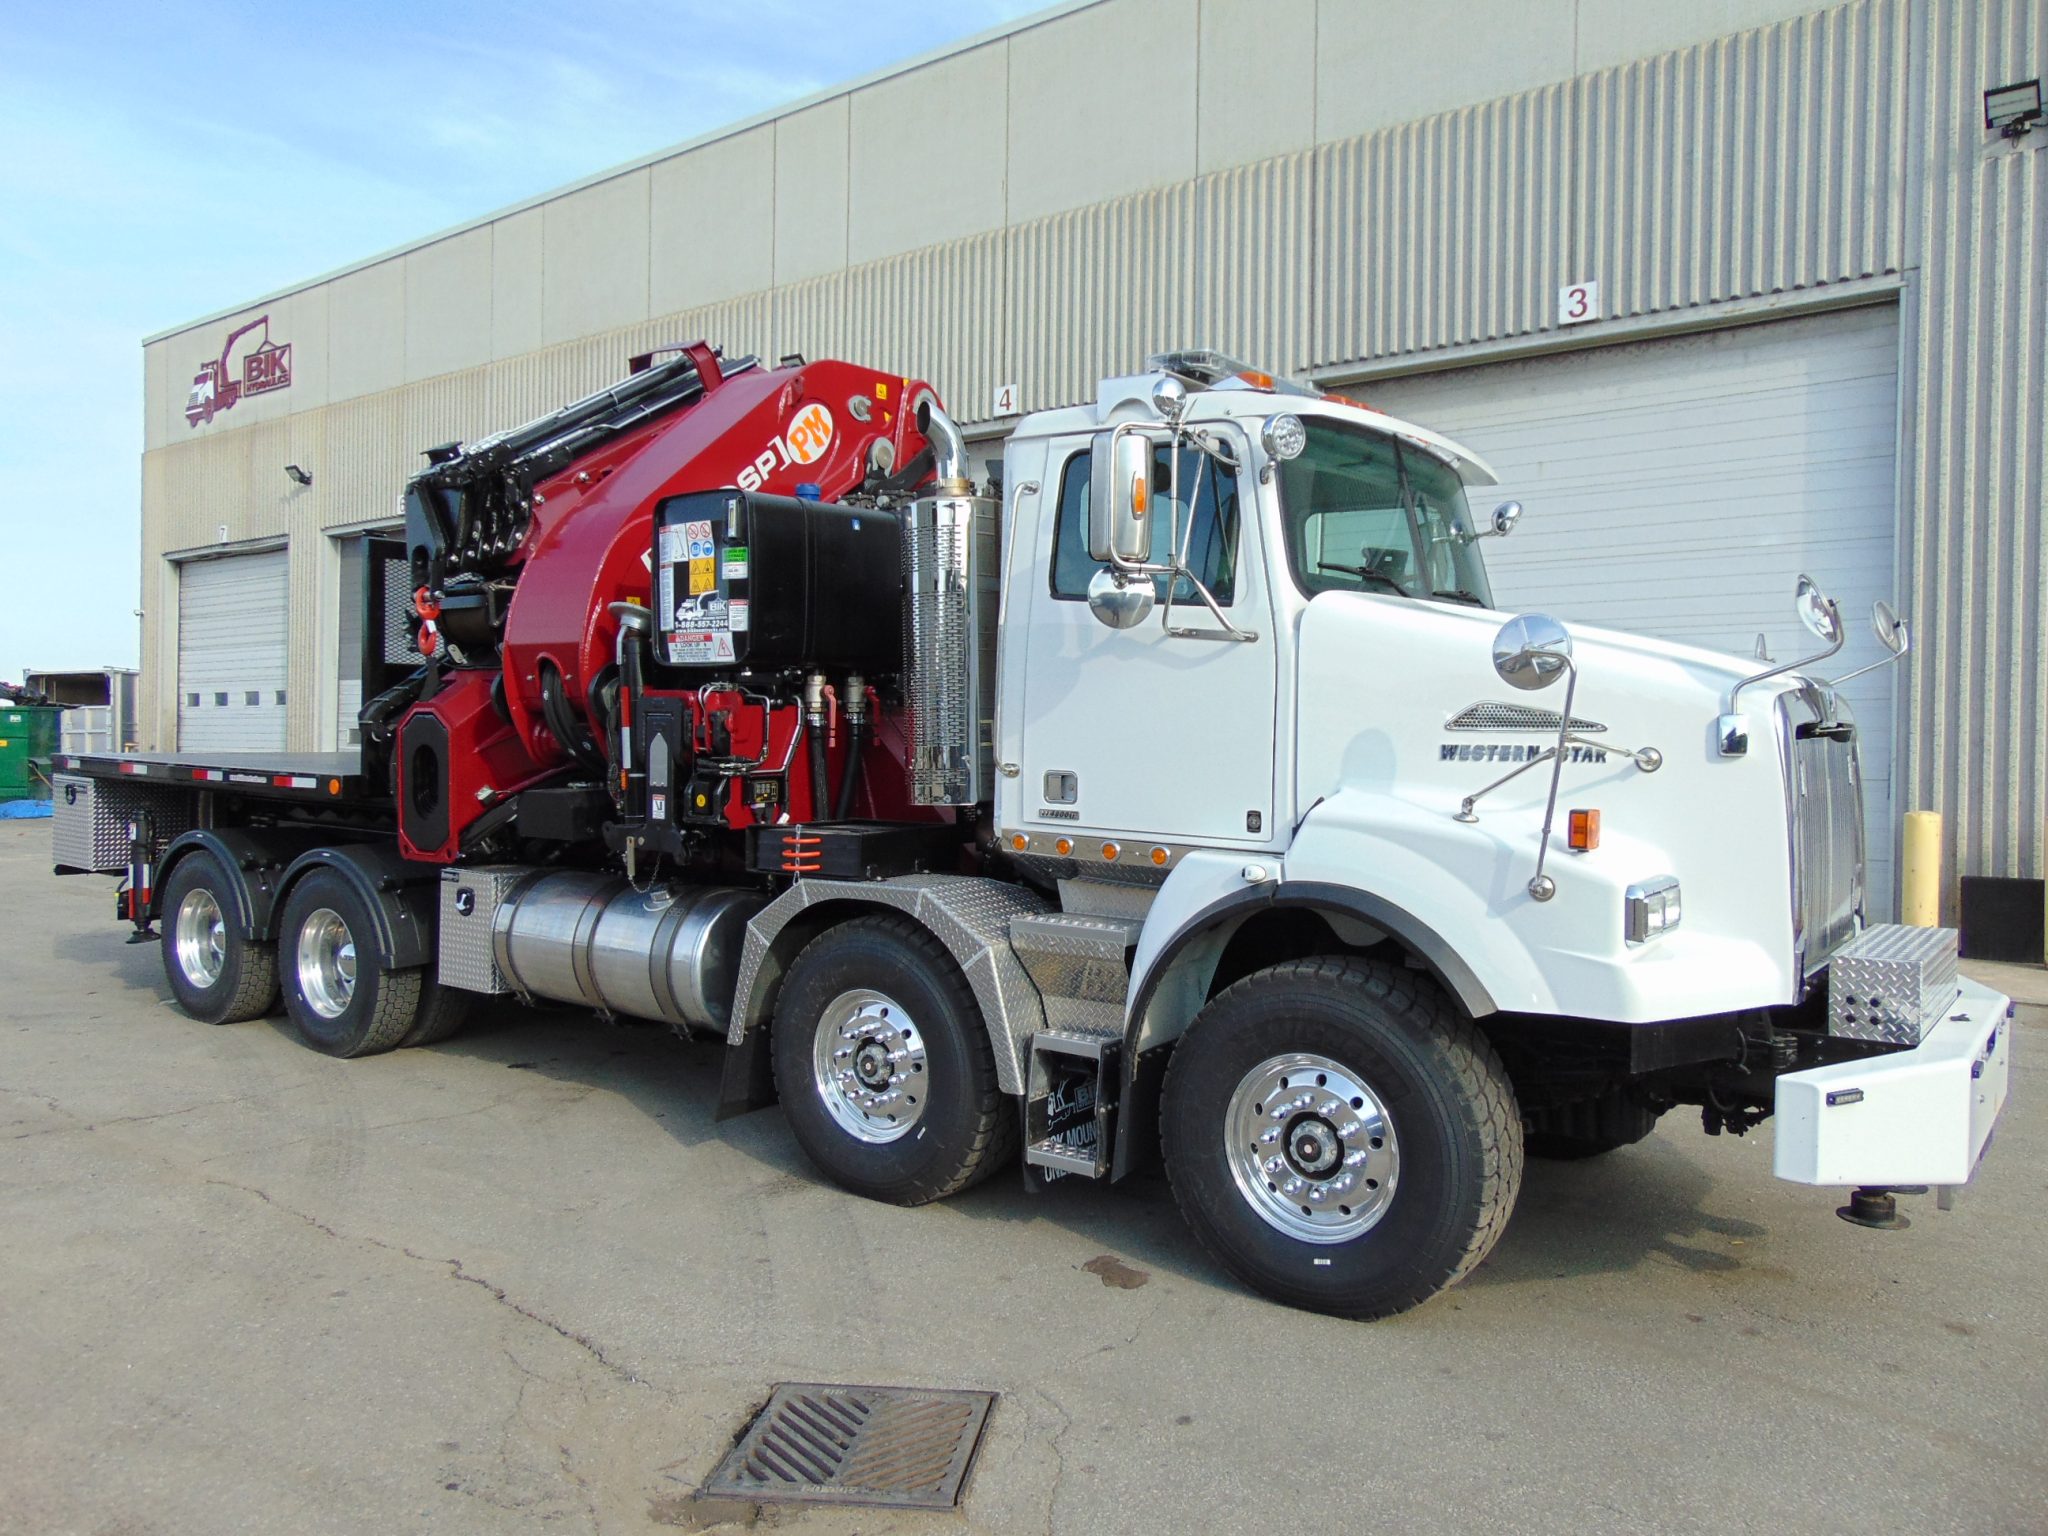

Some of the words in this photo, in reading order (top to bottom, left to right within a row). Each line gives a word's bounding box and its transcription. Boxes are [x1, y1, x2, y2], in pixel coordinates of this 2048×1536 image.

[1568, 288, 1588, 318] 3
[247, 348, 288, 382] BIK
[999, 389, 1011, 411] 4
[789, 406, 831, 464] PM
[710, 600, 726, 611] BIK
[680, 634, 705, 642] DANGER
[1440, 744, 1541, 762] WESTERN
